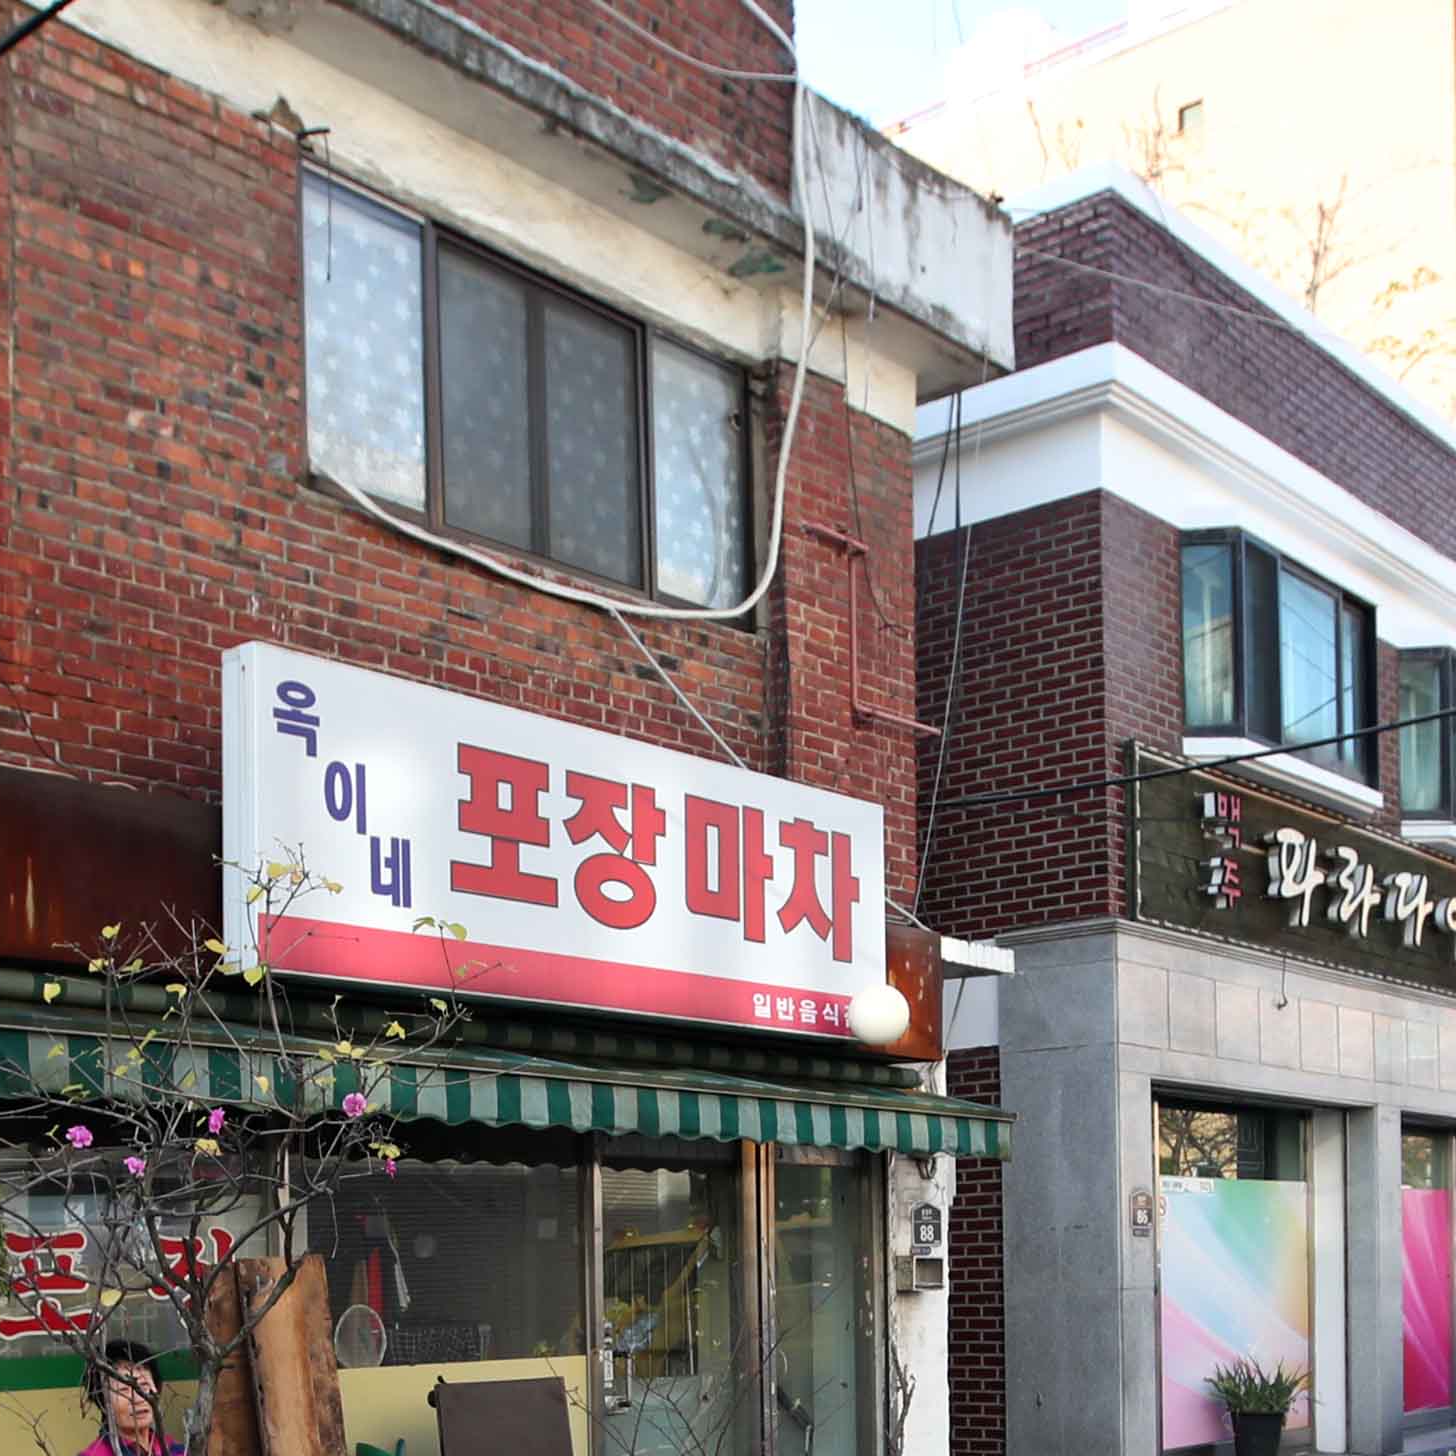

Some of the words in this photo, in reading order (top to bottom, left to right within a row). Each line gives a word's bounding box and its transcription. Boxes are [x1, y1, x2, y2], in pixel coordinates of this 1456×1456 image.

[273, 679, 412, 909] 옥이네
[1213, 792, 1242, 909] 맥주
[450, 742, 861, 964] 포장마차
[752, 992, 851, 1029] 일반음식
[920, 1224, 934, 1242] 88
